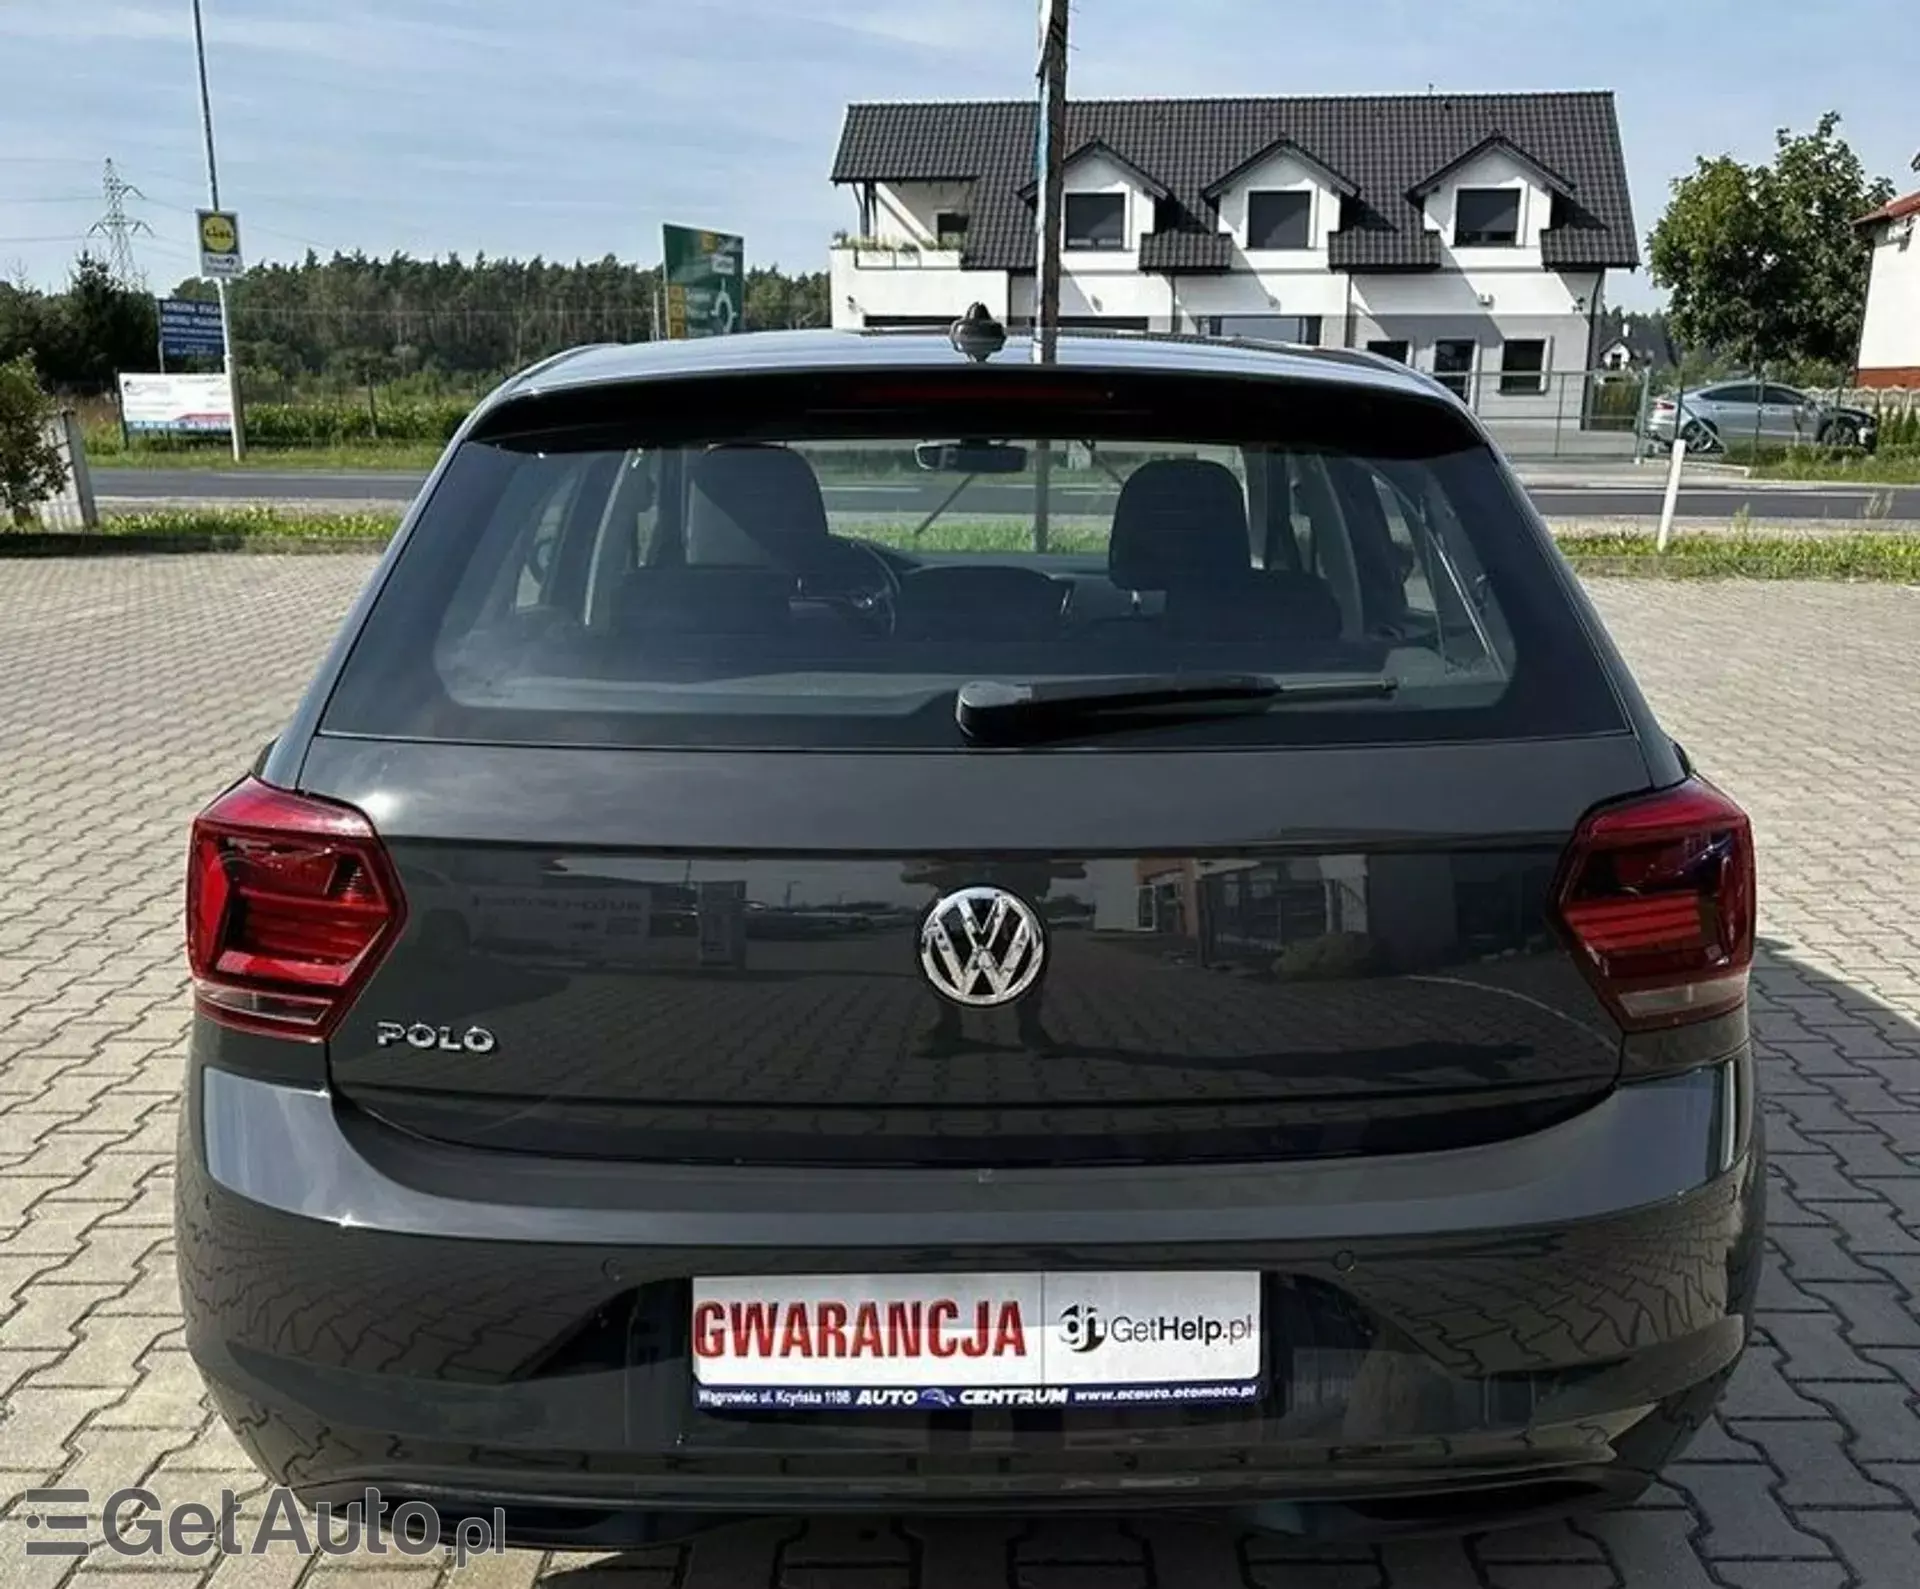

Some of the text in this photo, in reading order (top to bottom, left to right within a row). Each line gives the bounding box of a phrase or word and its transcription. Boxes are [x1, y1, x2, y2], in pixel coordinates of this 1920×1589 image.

[377, 1020, 495, 1053] POLO
[693, 1299, 1027, 1358] GWARANCJA
[1110, 1313, 1253, 1346] GetHelp.pl
[856, 1387, 1069, 1405] AUTO CENTRUM
